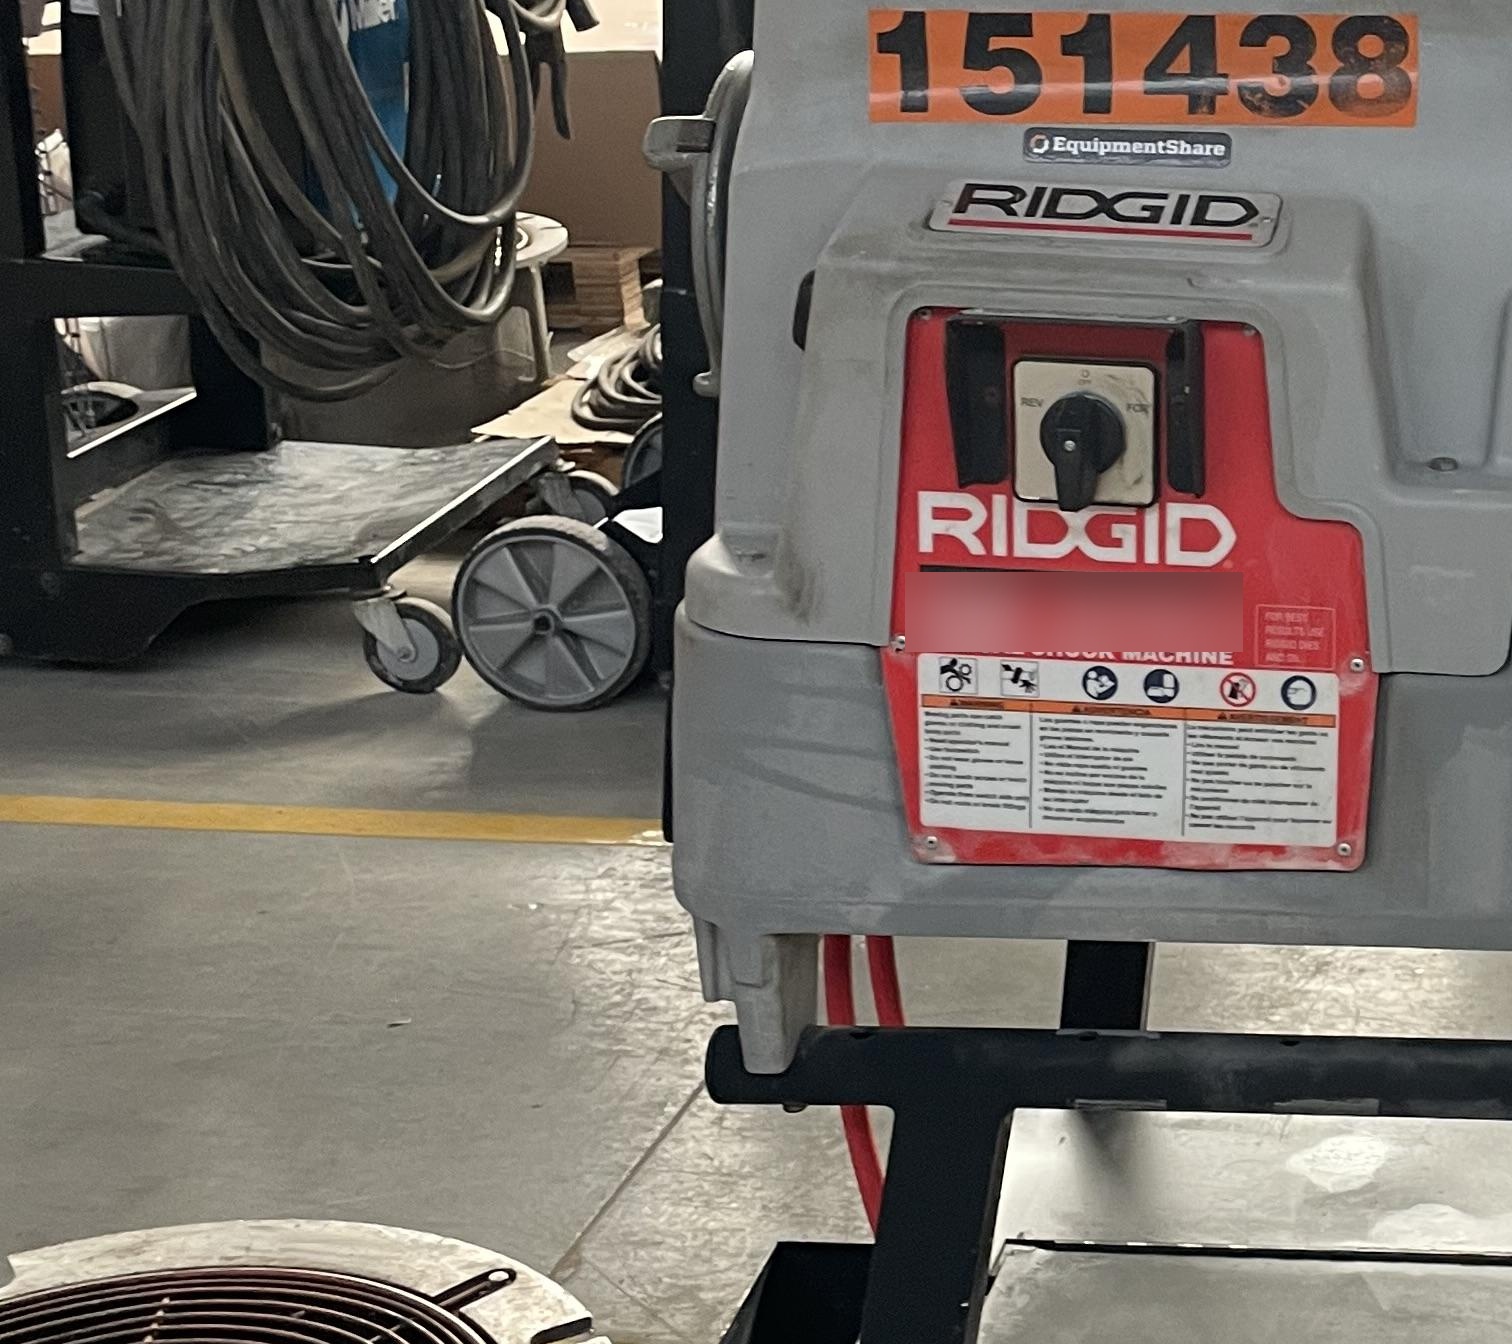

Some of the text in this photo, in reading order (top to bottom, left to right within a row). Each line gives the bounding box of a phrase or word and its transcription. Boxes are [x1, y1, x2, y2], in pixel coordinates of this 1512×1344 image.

[876, 10, 1413, 119] 151438
[1053, 136, 1226, 159] EquipmentShare
[951, 182, 1260, 228] RIDGID
[917, 490, 1237, 568] RIDGID
